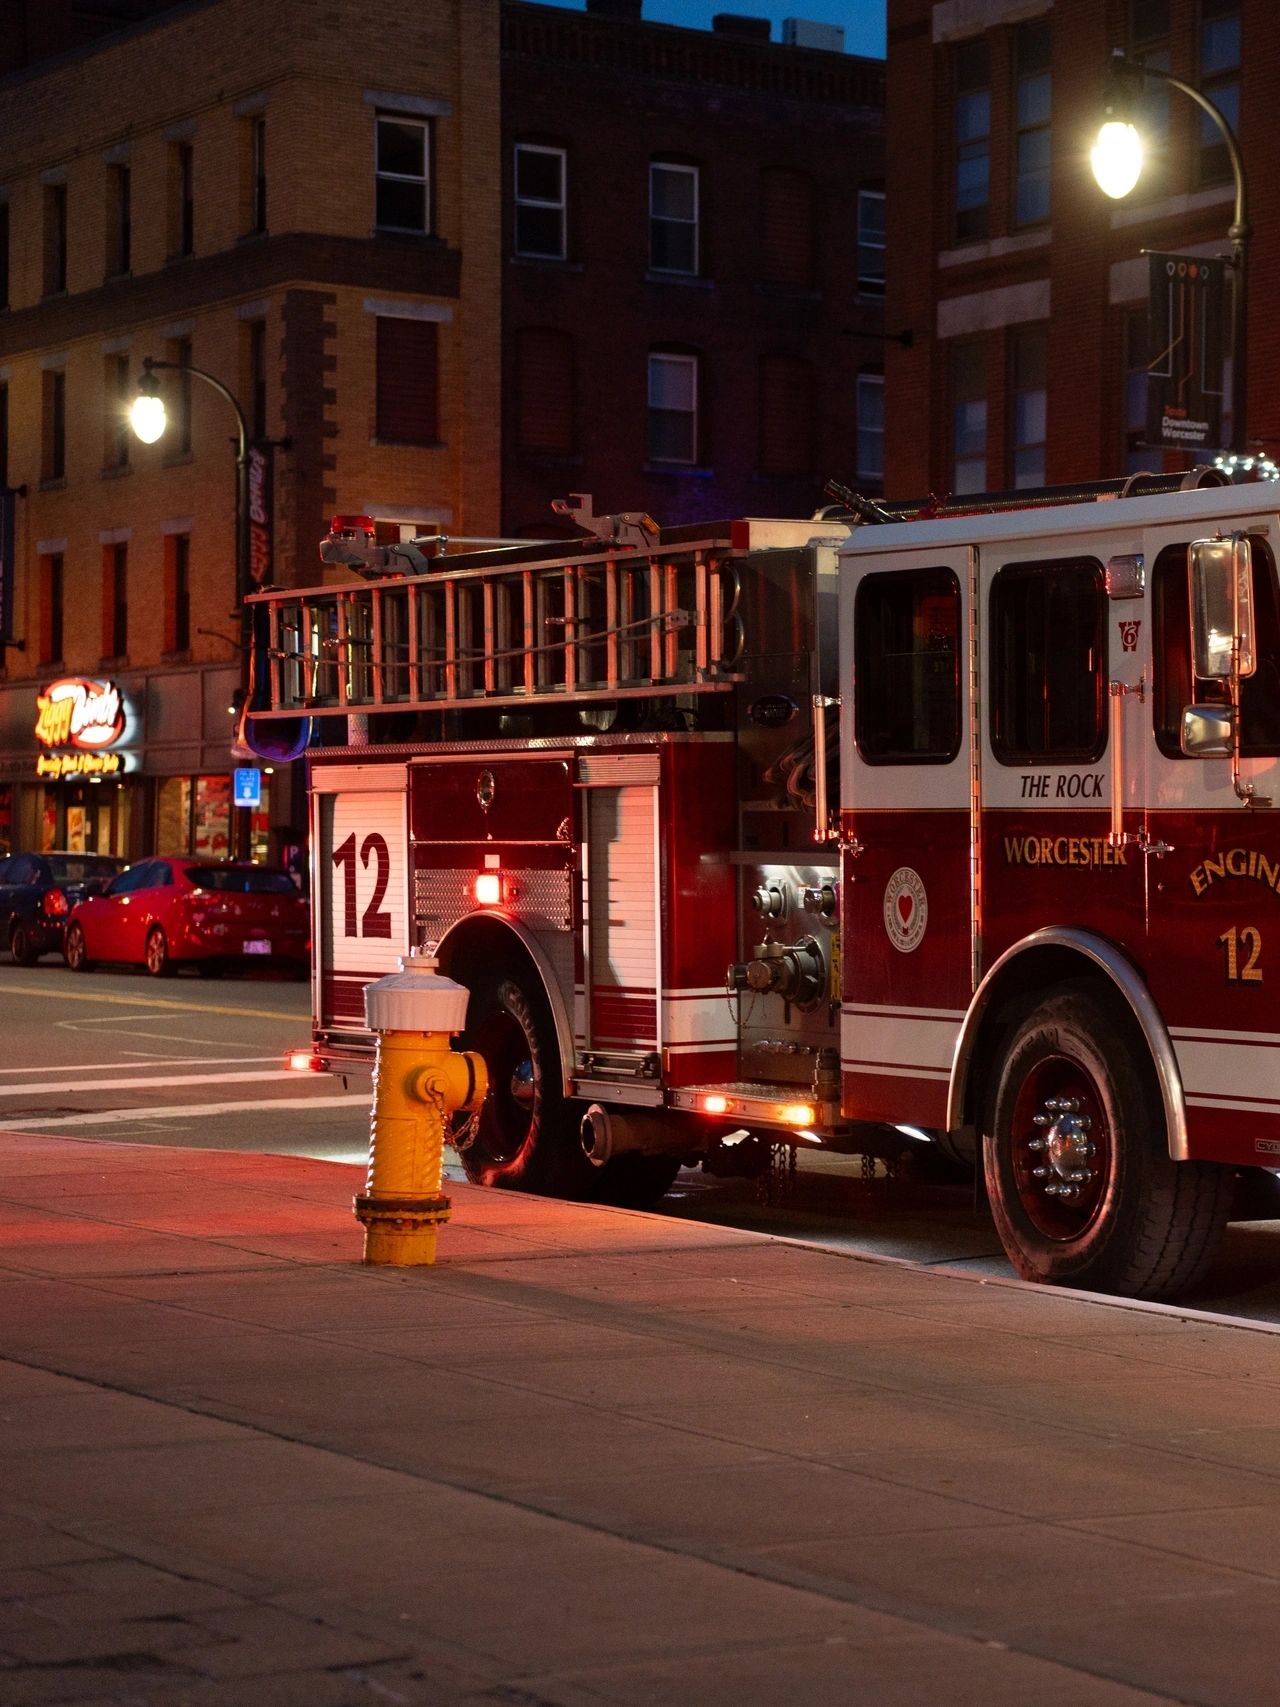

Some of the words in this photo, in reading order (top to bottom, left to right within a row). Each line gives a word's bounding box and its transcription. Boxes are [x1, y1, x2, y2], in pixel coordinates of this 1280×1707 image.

[1161, 416, 1209, 431] Downtown
[1161, 427, 1206, 441] Worcester
[1020, 775, 1051, 798] THE
[1056, 774, 1105, 798] ROCK
[1004, 836, 1127, 865] WORCESTER
[331, 832, 392, 939] 12
[1219, 925, 1263, 981] 12
